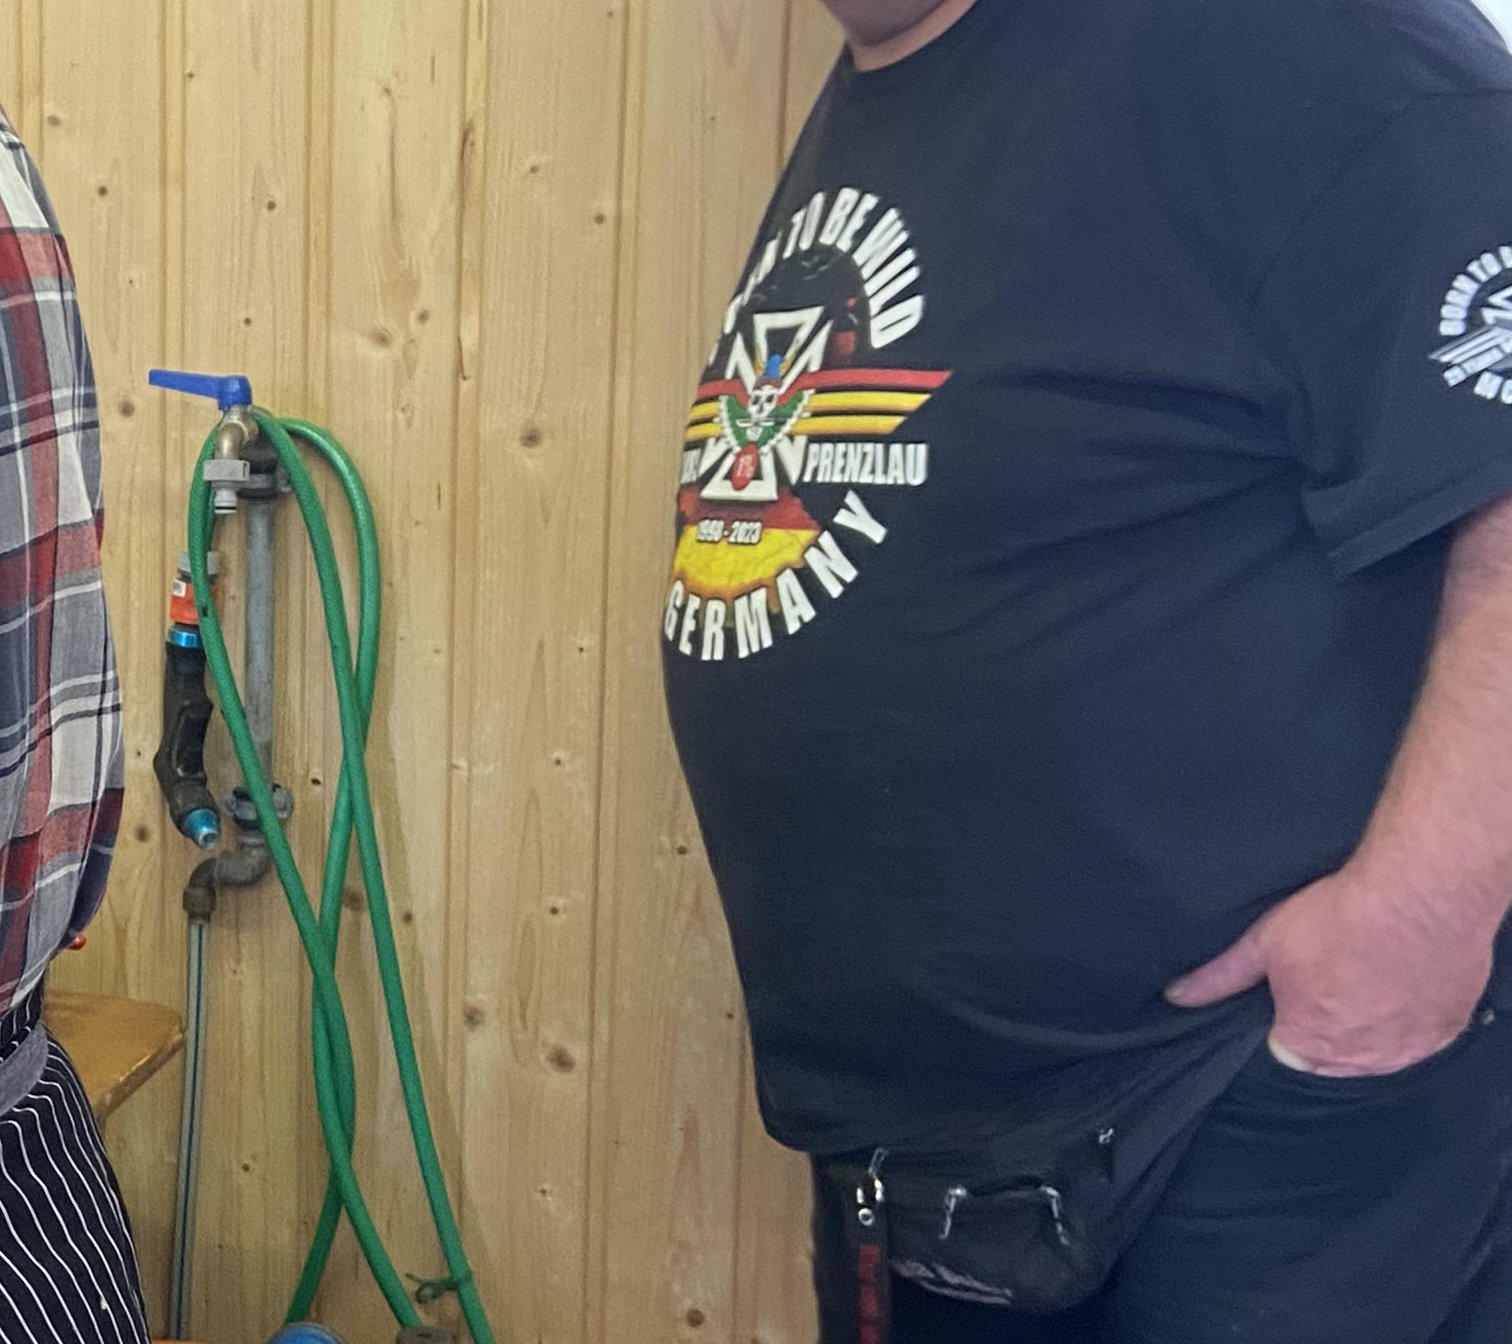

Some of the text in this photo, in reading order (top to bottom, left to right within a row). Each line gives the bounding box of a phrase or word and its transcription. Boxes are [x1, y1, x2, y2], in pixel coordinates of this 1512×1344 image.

[782, 191, 826, 258] TO
[818, 186, 880, 252] BE
[851, 207, 925, 349] WILD
[803, 443, 928, 486] PRENZLAU
[663, 490, 887, 661] GERMANY
